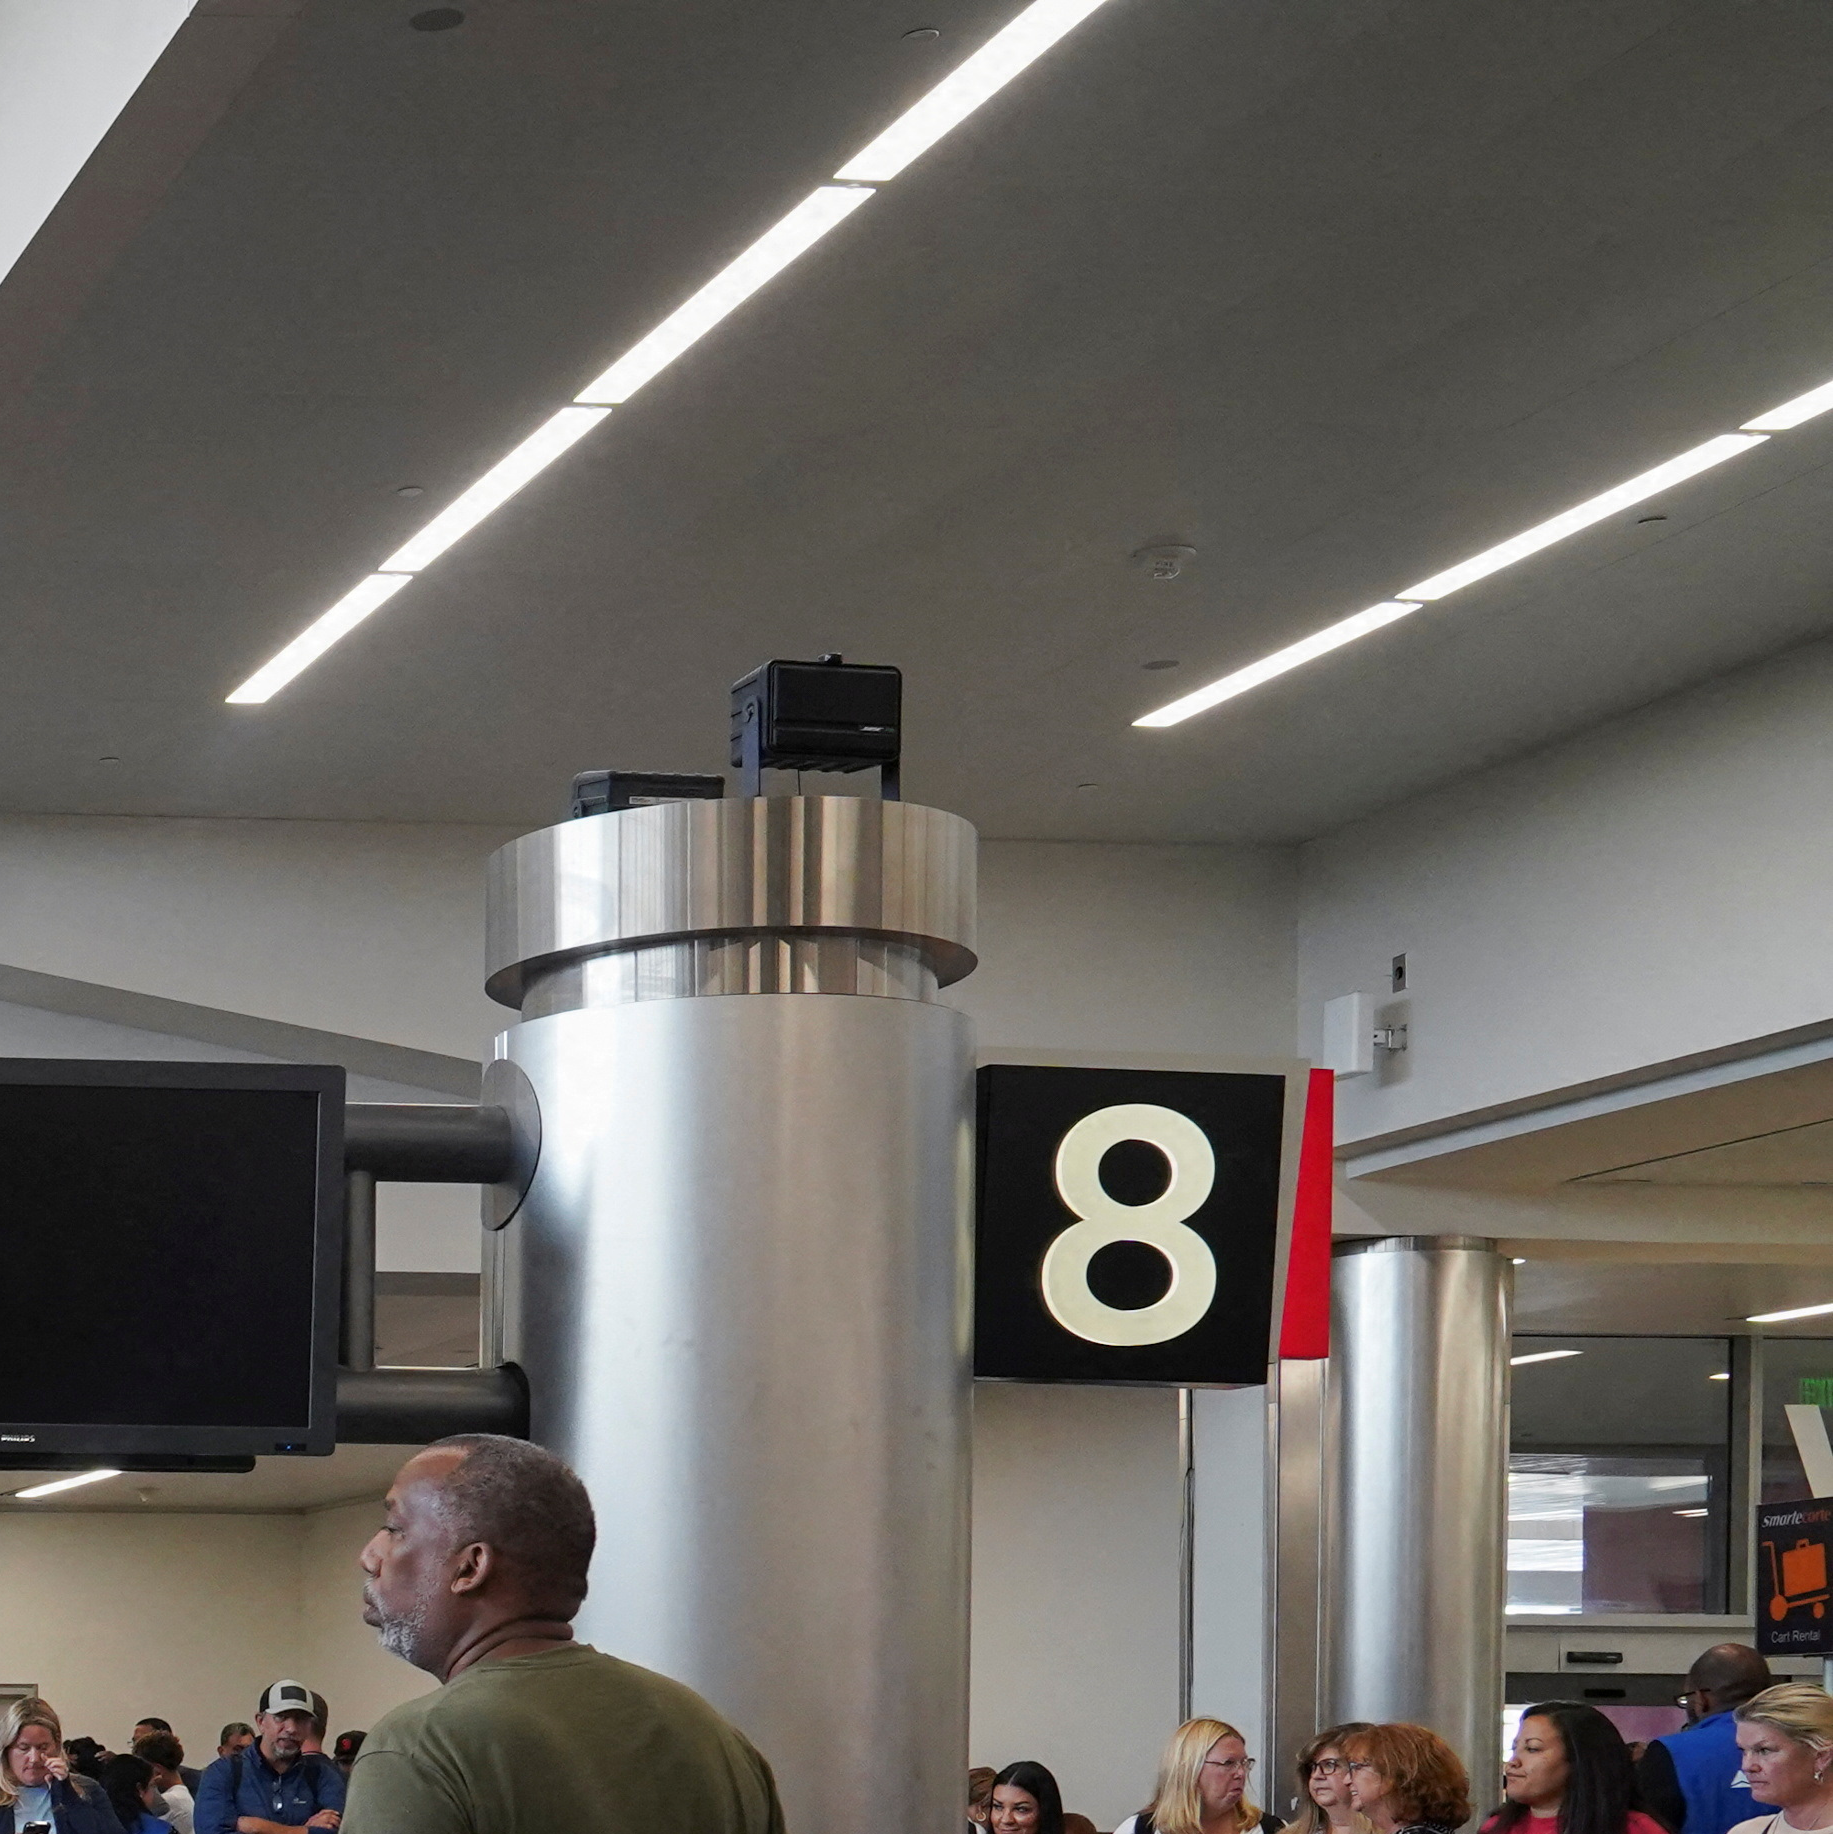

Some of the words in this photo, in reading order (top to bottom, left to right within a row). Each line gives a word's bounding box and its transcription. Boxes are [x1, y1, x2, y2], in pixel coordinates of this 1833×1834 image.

[1039, 1101, 1218, 1348] 8
[1771, 1630, 1791, 1644] Cart
[1792, 1628, 1821, 1643] Rental
